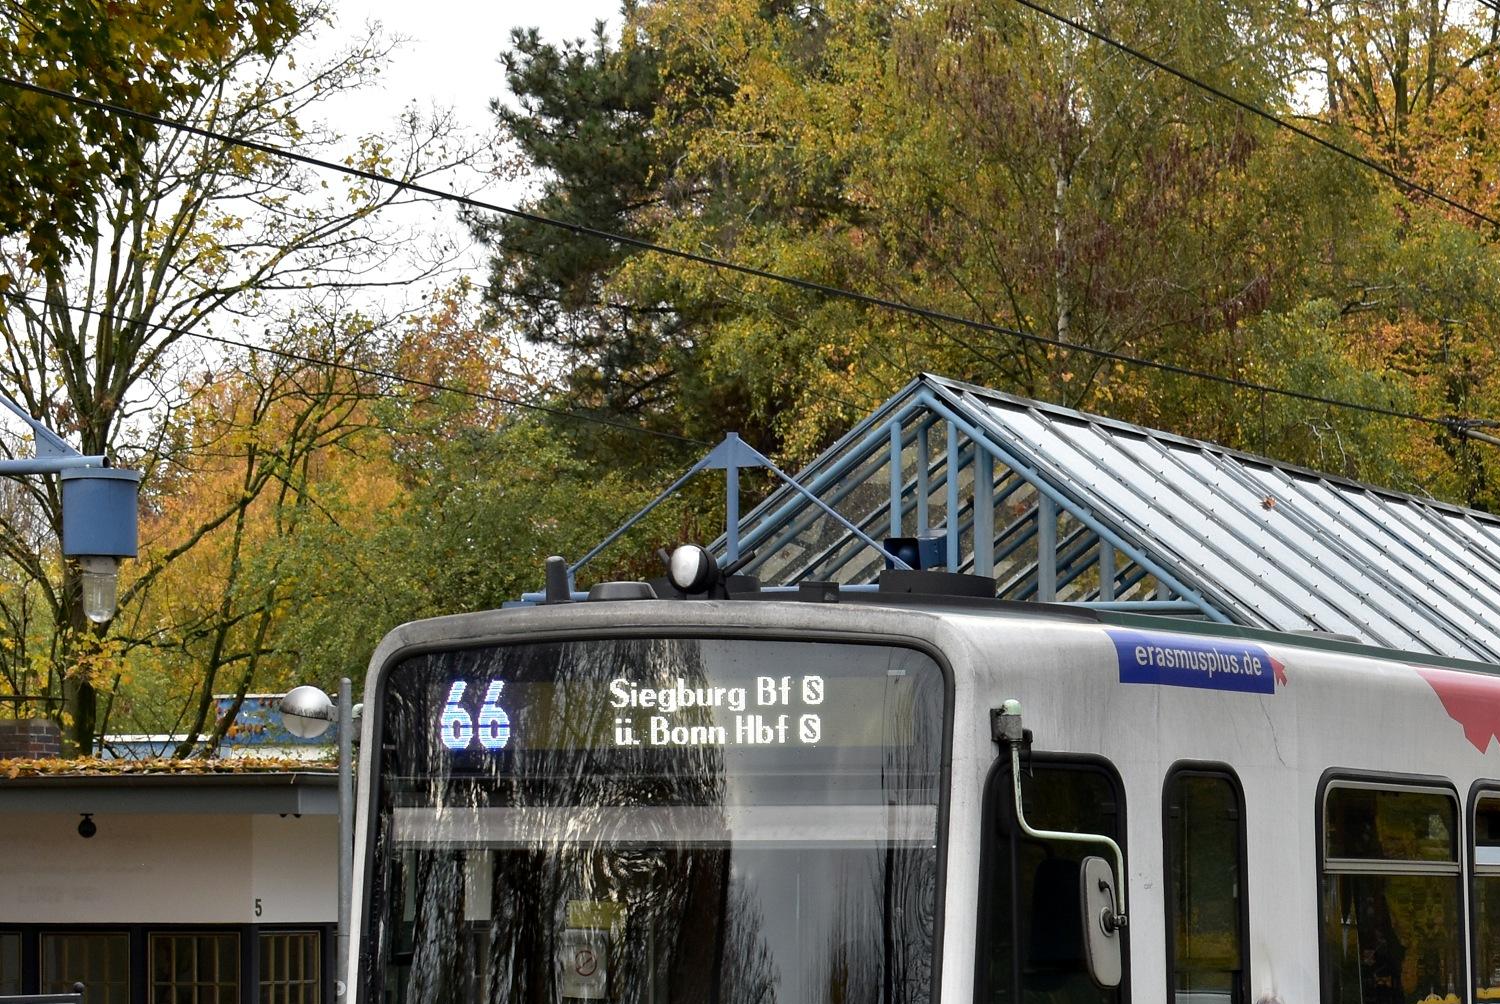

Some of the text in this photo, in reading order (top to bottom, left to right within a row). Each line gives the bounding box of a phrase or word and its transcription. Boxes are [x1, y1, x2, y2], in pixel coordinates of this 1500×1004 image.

[1135, 645, 1262, 678] erasmusplus.de
[609, 676, 746, 712] Siegburg
[757, 675, 791, 706] Bf
[440, 679, 511, 750] 66
[615, 718, 640, 746] ü.
[650, 716, 726, 746] Bonn
[735, 714, 789, 744] Hbf
[255, 898, 262, 917] 5
